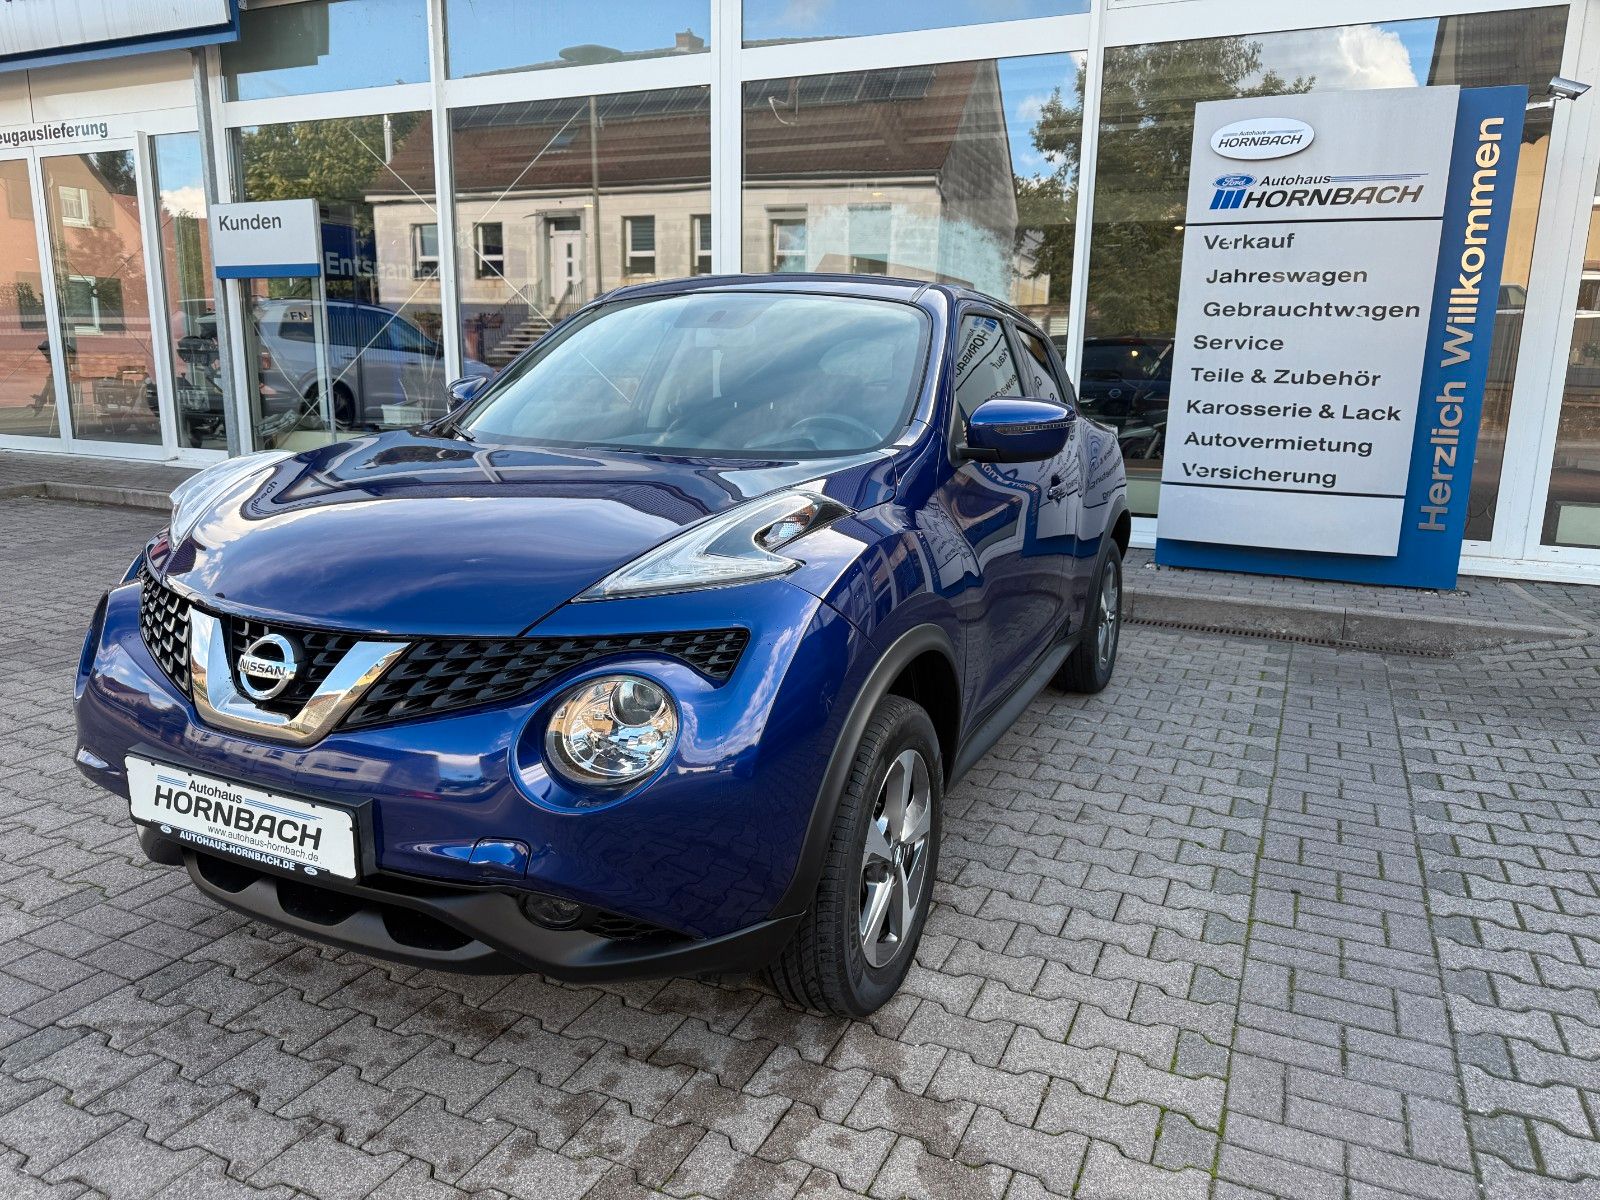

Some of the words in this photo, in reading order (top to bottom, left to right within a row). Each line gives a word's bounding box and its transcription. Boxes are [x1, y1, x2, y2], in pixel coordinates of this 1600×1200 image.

[1218, 134, 1303, 149] HORNBACH
[1221, 176, 1247, 187] Ford
[1259, 175, 1331, 187] Autohaus
[1242, 184, 1425, 209] HORNBACH
[219, 214, 282, 231] Kunden
[1204, 232, 1295, 250] Verkauf
[1440, 116, 1504, 368] Willkommen
[1205, 269, 1368, 287] Jahreswagen
[1203, 301, 1420, 321] Gebrauchtwagen
[1193, 334, 1284, 351] Service
[1190, 367, 1244, 383] Teile
[1250, 368, 1267, 384] &
[1273, 369, 1381, 387] Zubehör
[1186, 399, 1312, 418] Karosserie
[1318, 403, 1335, 419] &
[1342, 404, 1402, 421] Lack
[1183, 431, 1373, 457] Autovermietung
[1417, 381, 1466, 532] Herzlich
[1181, 462, 1337, 488] Versicherung
[240, 657, 286, 676] NISSAN
[188, 779, 242, 804] Autohaus
[154, 784, 323, 851] HORNBACH
[179, 830, 296, 872] AUTOHAUS-HORNBACH.DE
[207, 824, 319, 862] www.autohaus-hornbach.de
